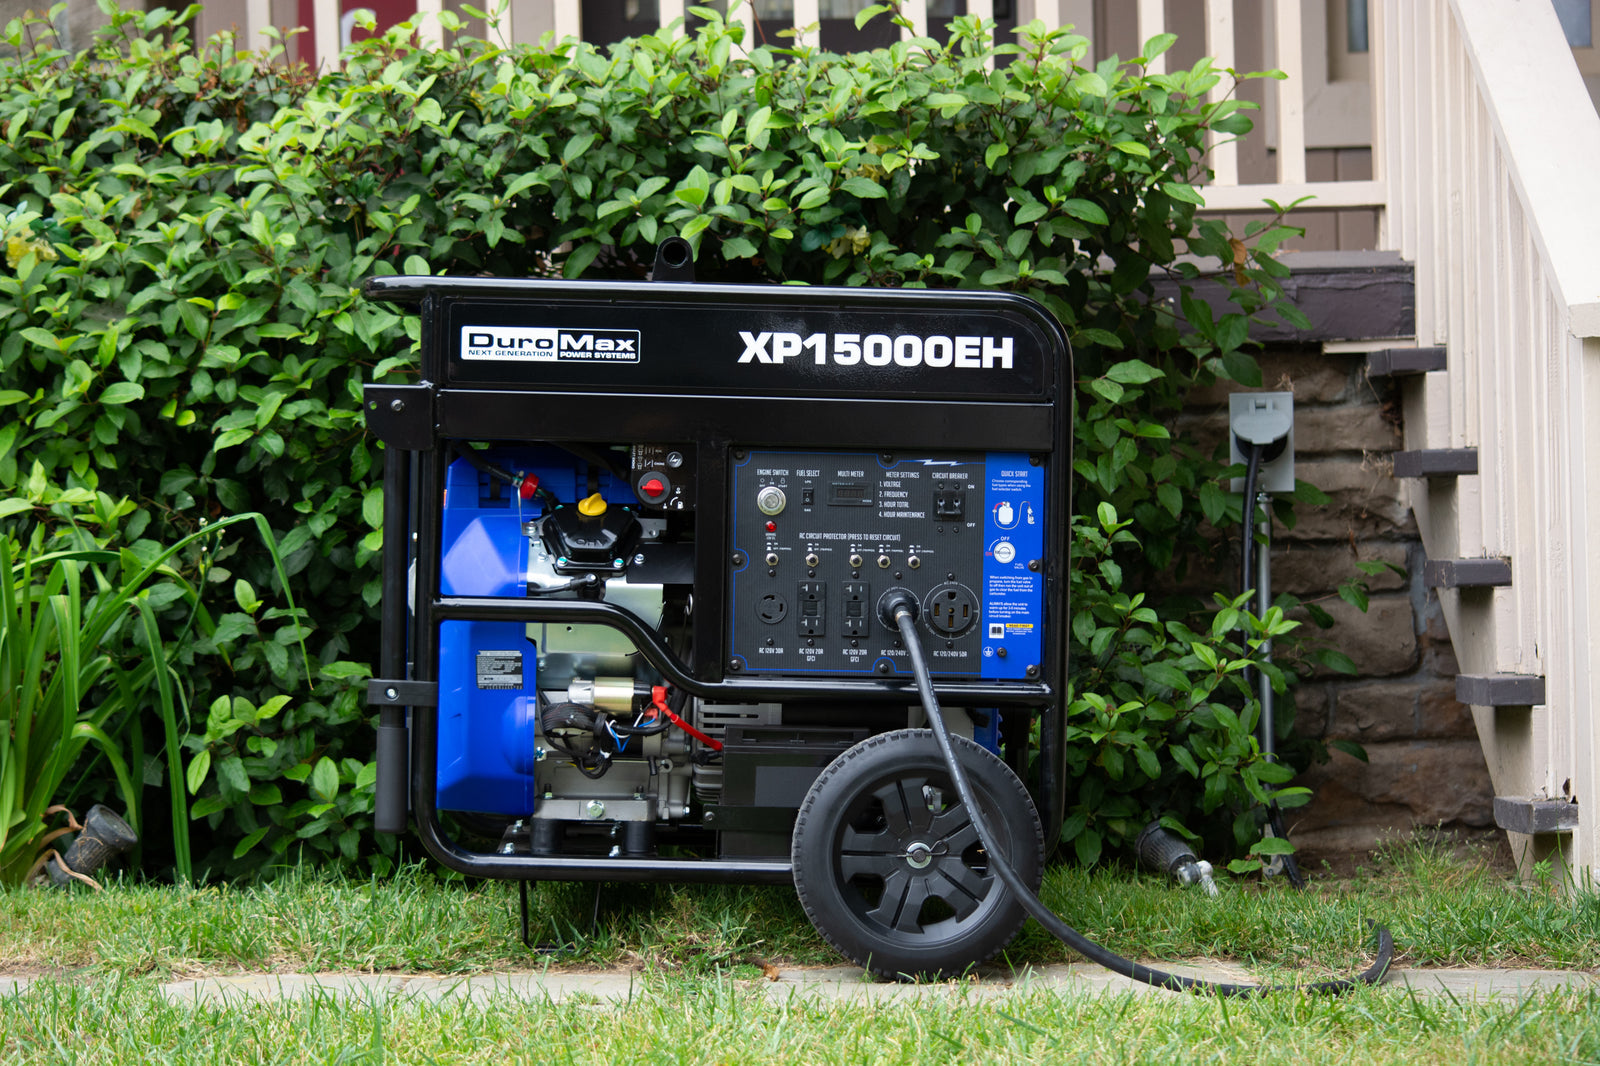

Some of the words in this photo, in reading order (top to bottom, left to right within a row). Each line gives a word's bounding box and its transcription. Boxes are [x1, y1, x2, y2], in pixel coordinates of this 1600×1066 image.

[560, 351, 592, 359] POWER
[594, 352, 636, 360] SYSTEMS
[737, 331, 1014, 369] XP15000EH
